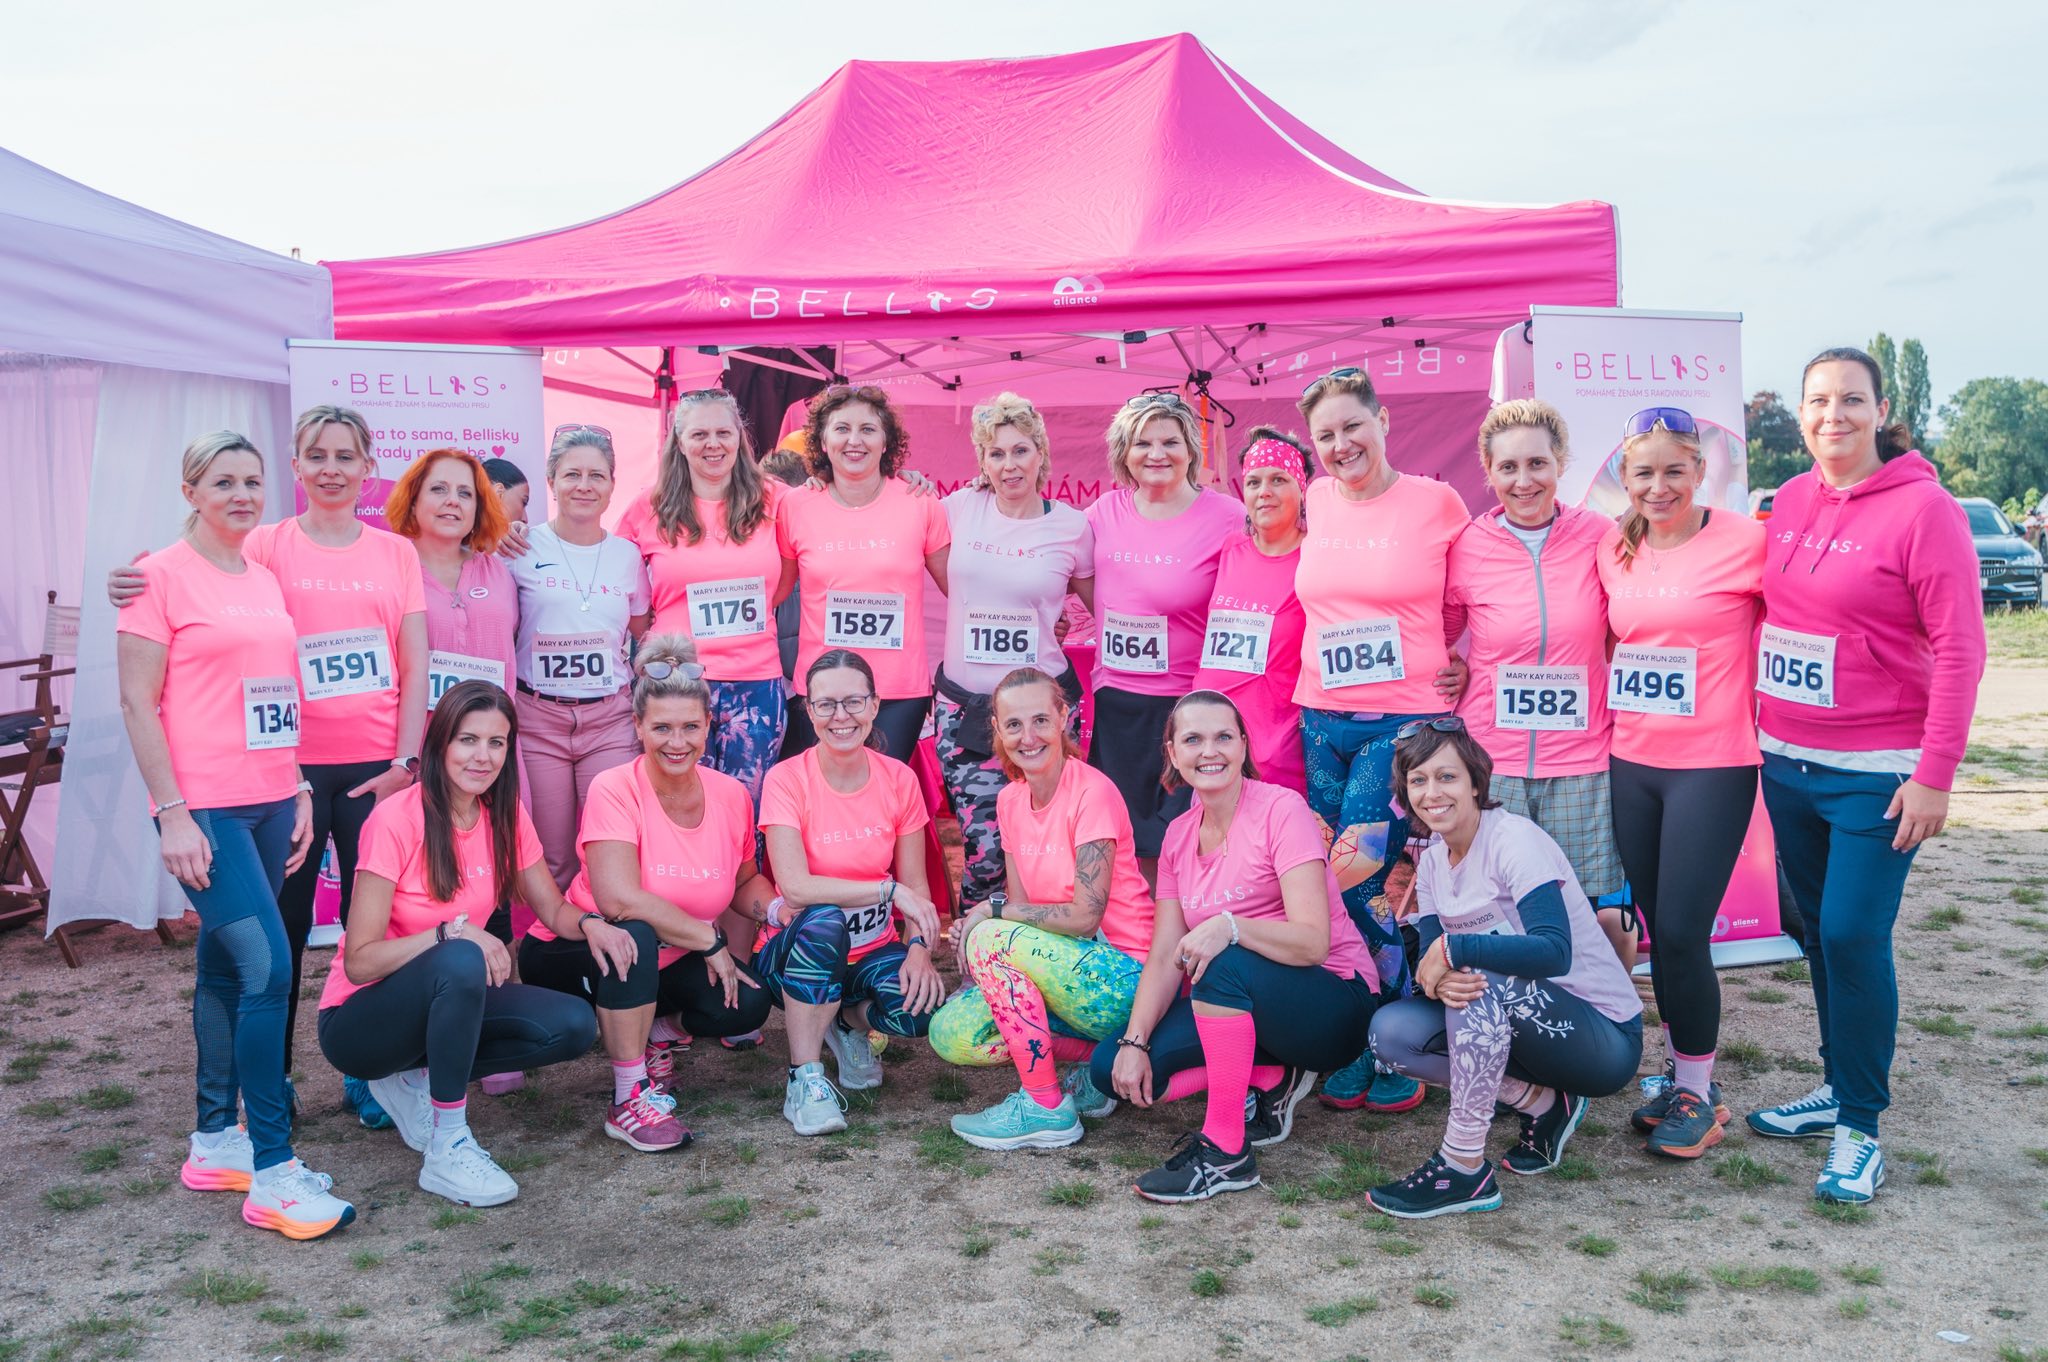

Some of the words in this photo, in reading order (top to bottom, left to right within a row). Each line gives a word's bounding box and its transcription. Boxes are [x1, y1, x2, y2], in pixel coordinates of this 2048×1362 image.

[391, 429, 407, 441] to
[411, 430, 458, 443] sama,
[463, 429, 520, 444] Bellisky
[376, 446, 412, 461] tady
[693, 587, 713, 596] MARY
[744, 583, 759, 591] 2025
[833, 596, 852, 604] MARY
[853, 597, 867, 605] KAY
[867, 598, 882, 606] RUN
[698, 598, 757, 627] 1176
[969, 612, 987, 620] MARY
[831, 611, 895, 636] 1587
[1249, 619, 1266, 627] 2025
[1322, 632, 1340, 640] MARY
[1340, 629, 1355, 638] KAY
[1356, 626, 1373, 635] RUN
[1373, 624, 1392, 632] 2025
[305, 641, 328, 650] MARY
[329, 638, 345, 647] KAY
[345, 636, 363, 645] RUN
[362, 634, 379, 643] 2025
[537, 639, 557, 647] MARY
[558, 639, 573, 647] KAY
[573, 638, 588, 646] RUN
[970, 627, 1029, 653] 1186
[1105, 631, 1160, 659] 1664
[1210, 632, 1258, 660] 1221
[1764, 633, 1779, 643] MARY
[1778, 636, 1792, 647] KAY
[1792, 639, 1808, 650] RUN
[1807, 643, 1826, 653] 2025
[432, 657, 453, 667] MARY
[468, 663, 483, 671] RUN
[482, 665, 498, 674] 2025
[538, 652, 605, 679] 1250
[1322, 640, 1396, 675] 1084
[1635, 653, 1650, 661] KAY
[1650, 654, 1668, 662] RUN
[308, 650, 379, 684] 1591
[1505, 671, 1528, 680] MARY
[1563, 672, 1580, 680] 2025
[1762, 651, 1823, 691] 1056
[250, 686, 271, 694] MARY
[1614, 668, 1685, 701] 1496
[1503, 688, 1577, 716] 1582
[846, 902, 888, 935] 425
[1463, 919, 1478, 929] RUN
[1476, 911, 1495, 925] 2025
